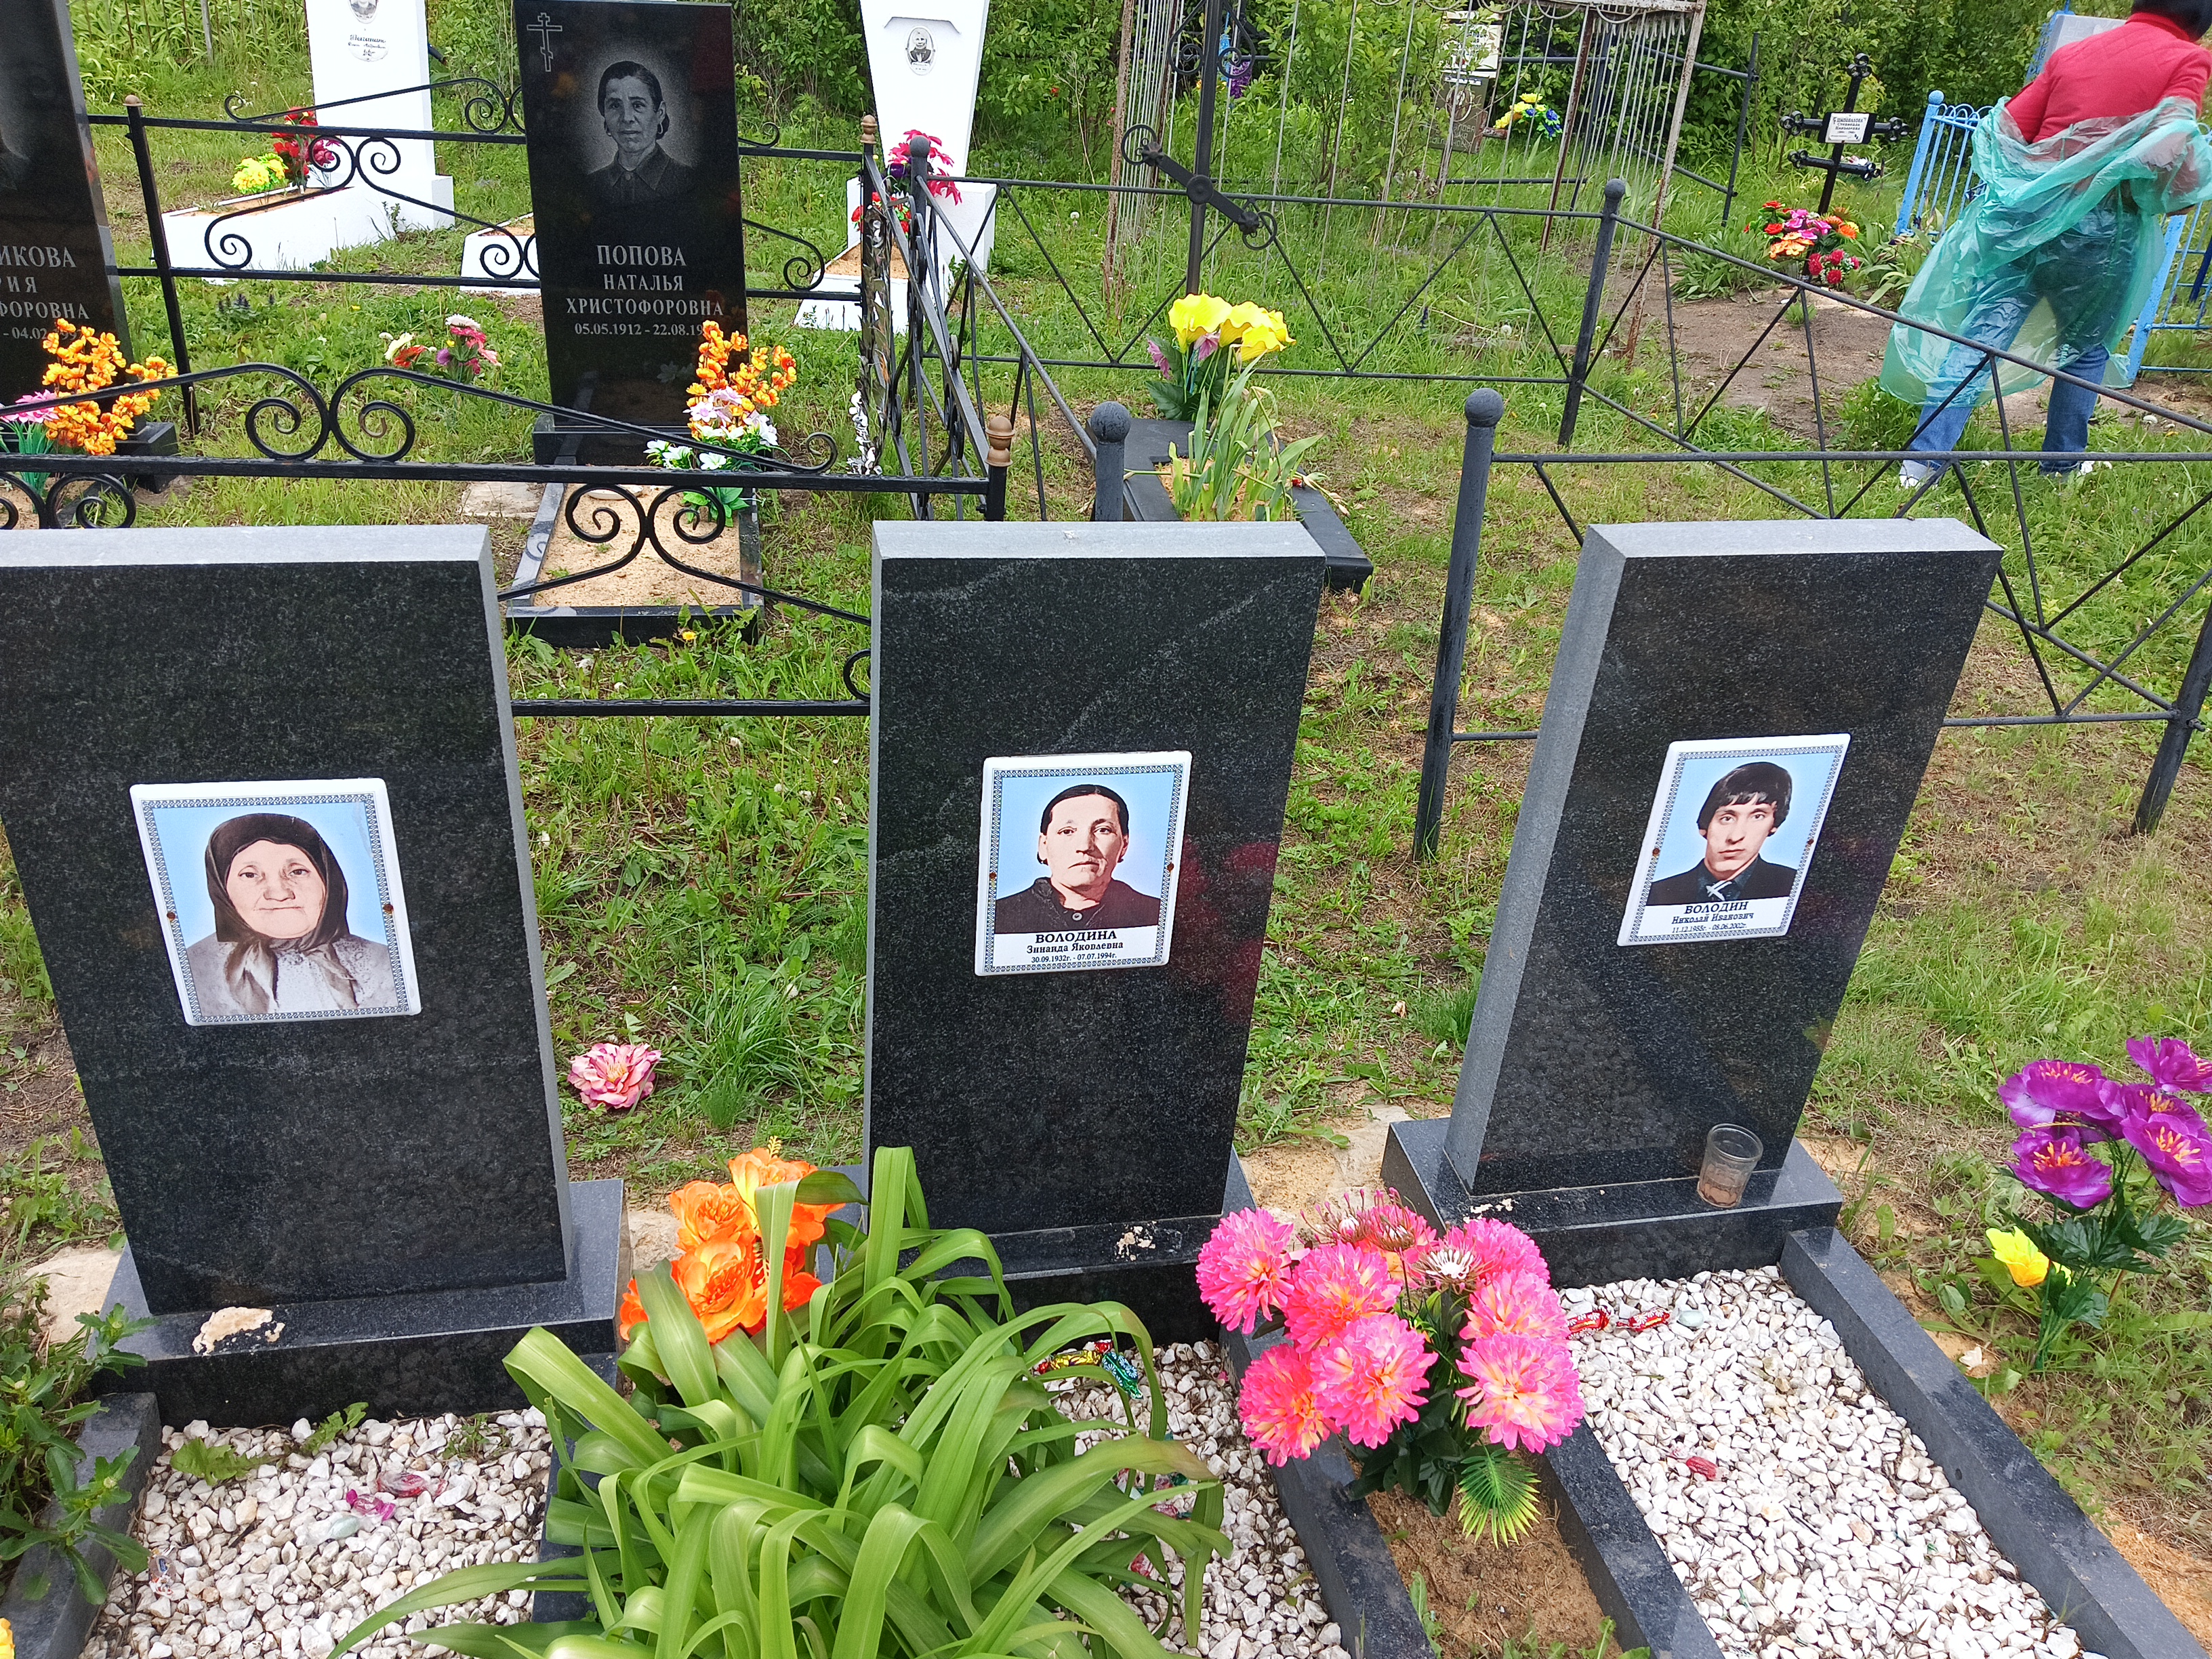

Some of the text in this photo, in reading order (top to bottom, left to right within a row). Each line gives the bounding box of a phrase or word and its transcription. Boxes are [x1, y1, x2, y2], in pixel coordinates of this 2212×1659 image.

[596, 245, 687, 266] ПОПОВА
[0, 276, 38, 293] ИЯ
[603, 274, 684, 291] НАТАЛЬЯ
[566, 298, 724, 316] ХРИСТОФОРОВНА
[575, 323, 642, 335] 05.05.1912
[653, 324, 703, 336] 22.08.19
[1684, 901, 1749, 914] ВОЛОДИН
[1671, 913, 1755, 924] Николай Иванович
[1035, 930, 1118, 943] ВОЛОДИНА
[1071, 942, 1124, 951] Яковлевна
[1031, 955, 1071, 963] 30.09.1932г.
[1077, 952, 1118, 961] 07.07.1994г.
